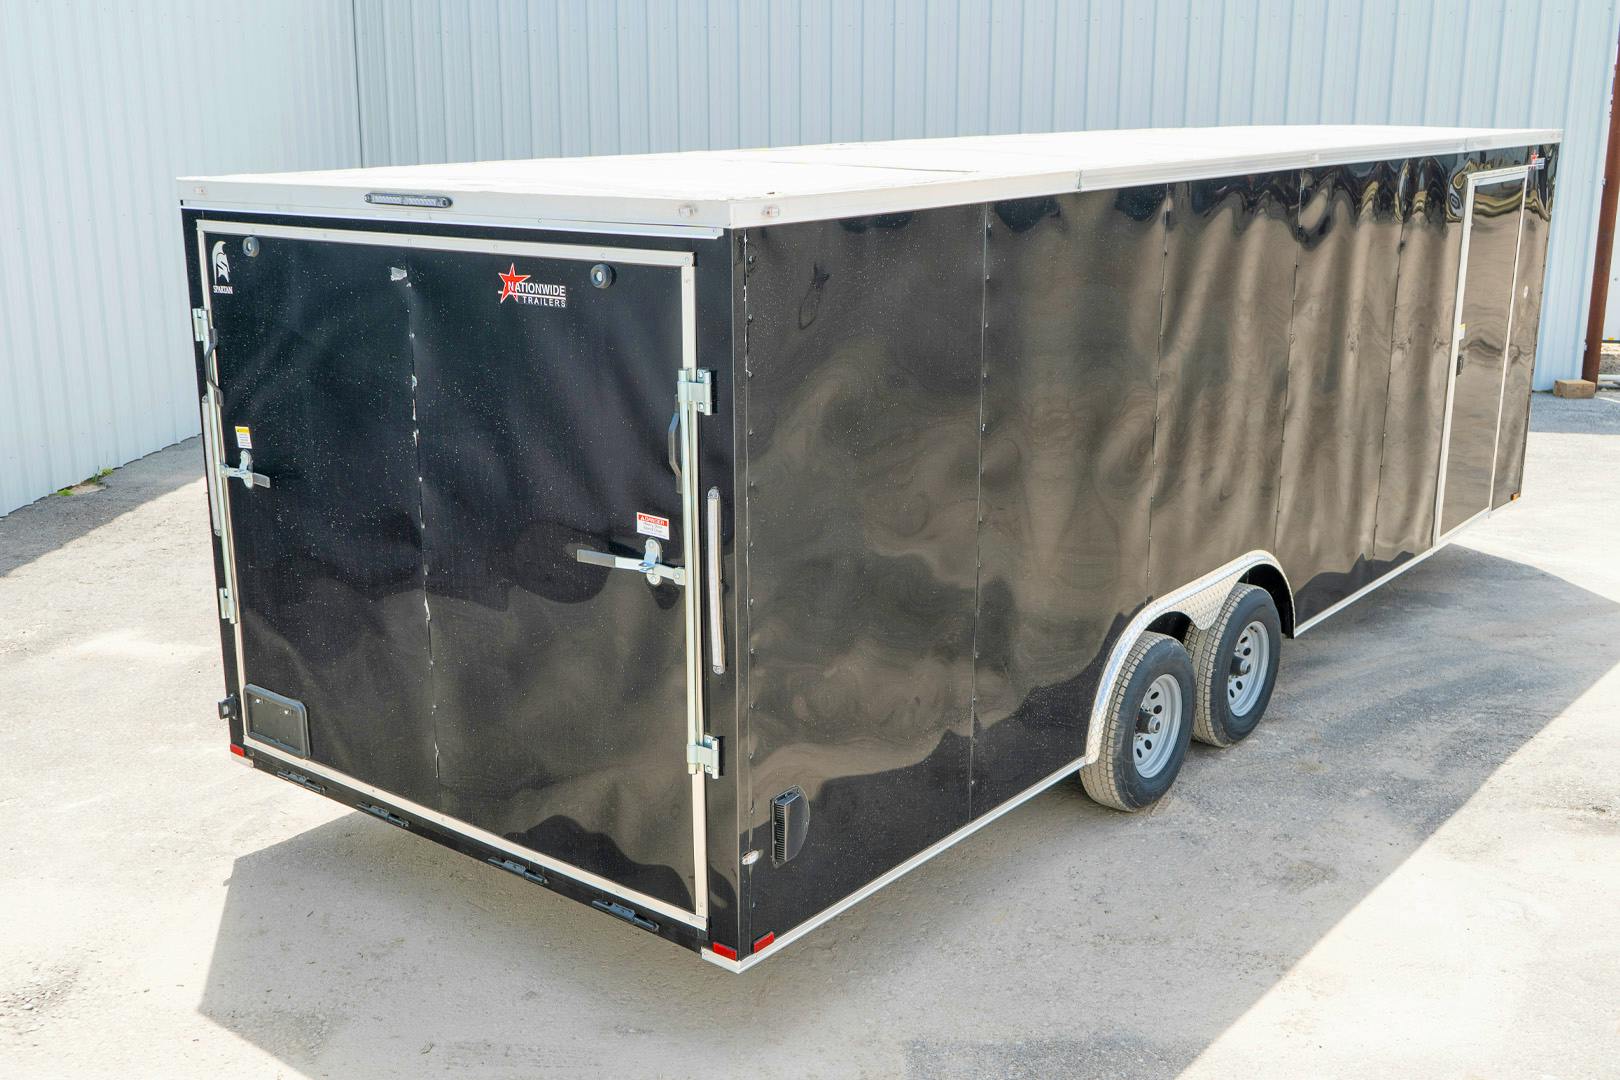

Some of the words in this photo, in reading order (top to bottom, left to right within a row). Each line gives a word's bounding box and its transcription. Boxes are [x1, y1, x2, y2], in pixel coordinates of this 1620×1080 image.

[213, 285, 233, 294] SPARTAN
[507, 281, 566, 296] NATIONWIDE
[523, 296, 566, 308] TRAILERS
